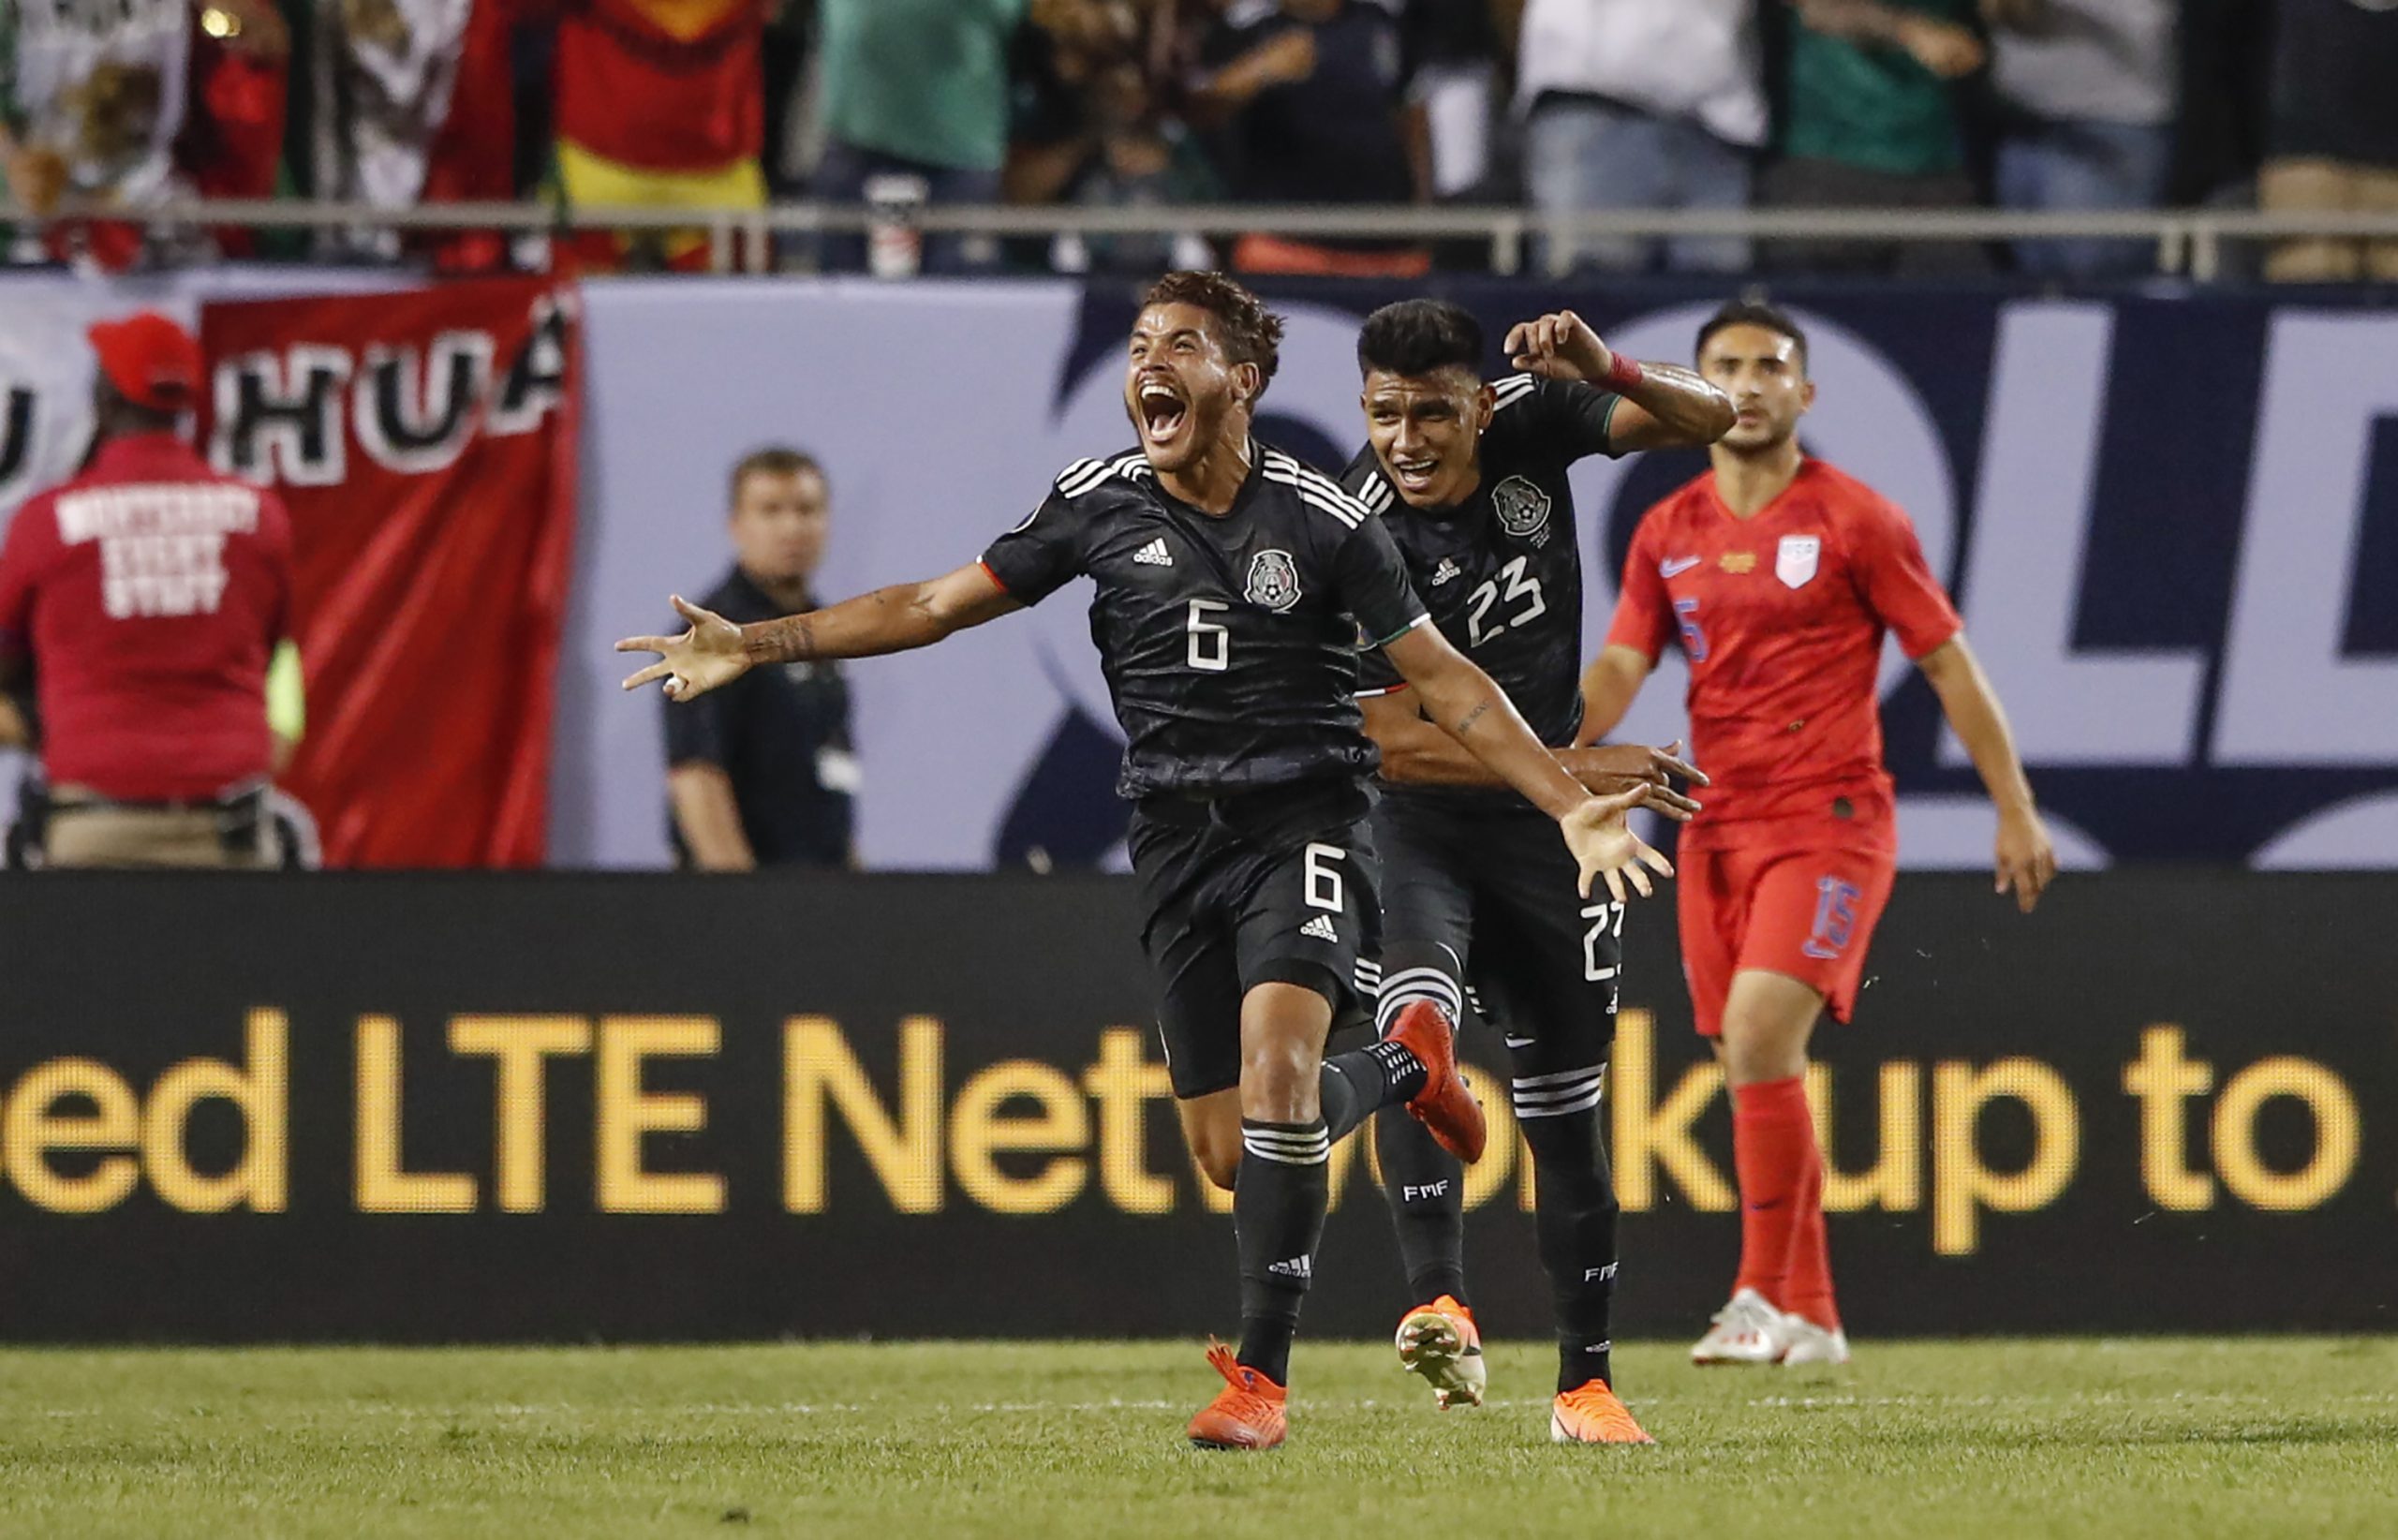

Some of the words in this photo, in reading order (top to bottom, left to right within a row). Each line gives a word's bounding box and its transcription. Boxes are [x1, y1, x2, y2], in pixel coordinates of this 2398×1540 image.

[1187, 599, 1229, 671] 6
[1467, 555, 1547, 647] 23
[1304, 842, 1346, 913] 6
[354, 1013, 728, 1214] LTE
[1801, 1055, 2080, 1257] up
[2122, 1022, 2361, 1211] to
[1403, 1179, 1448, 1202] FMF
